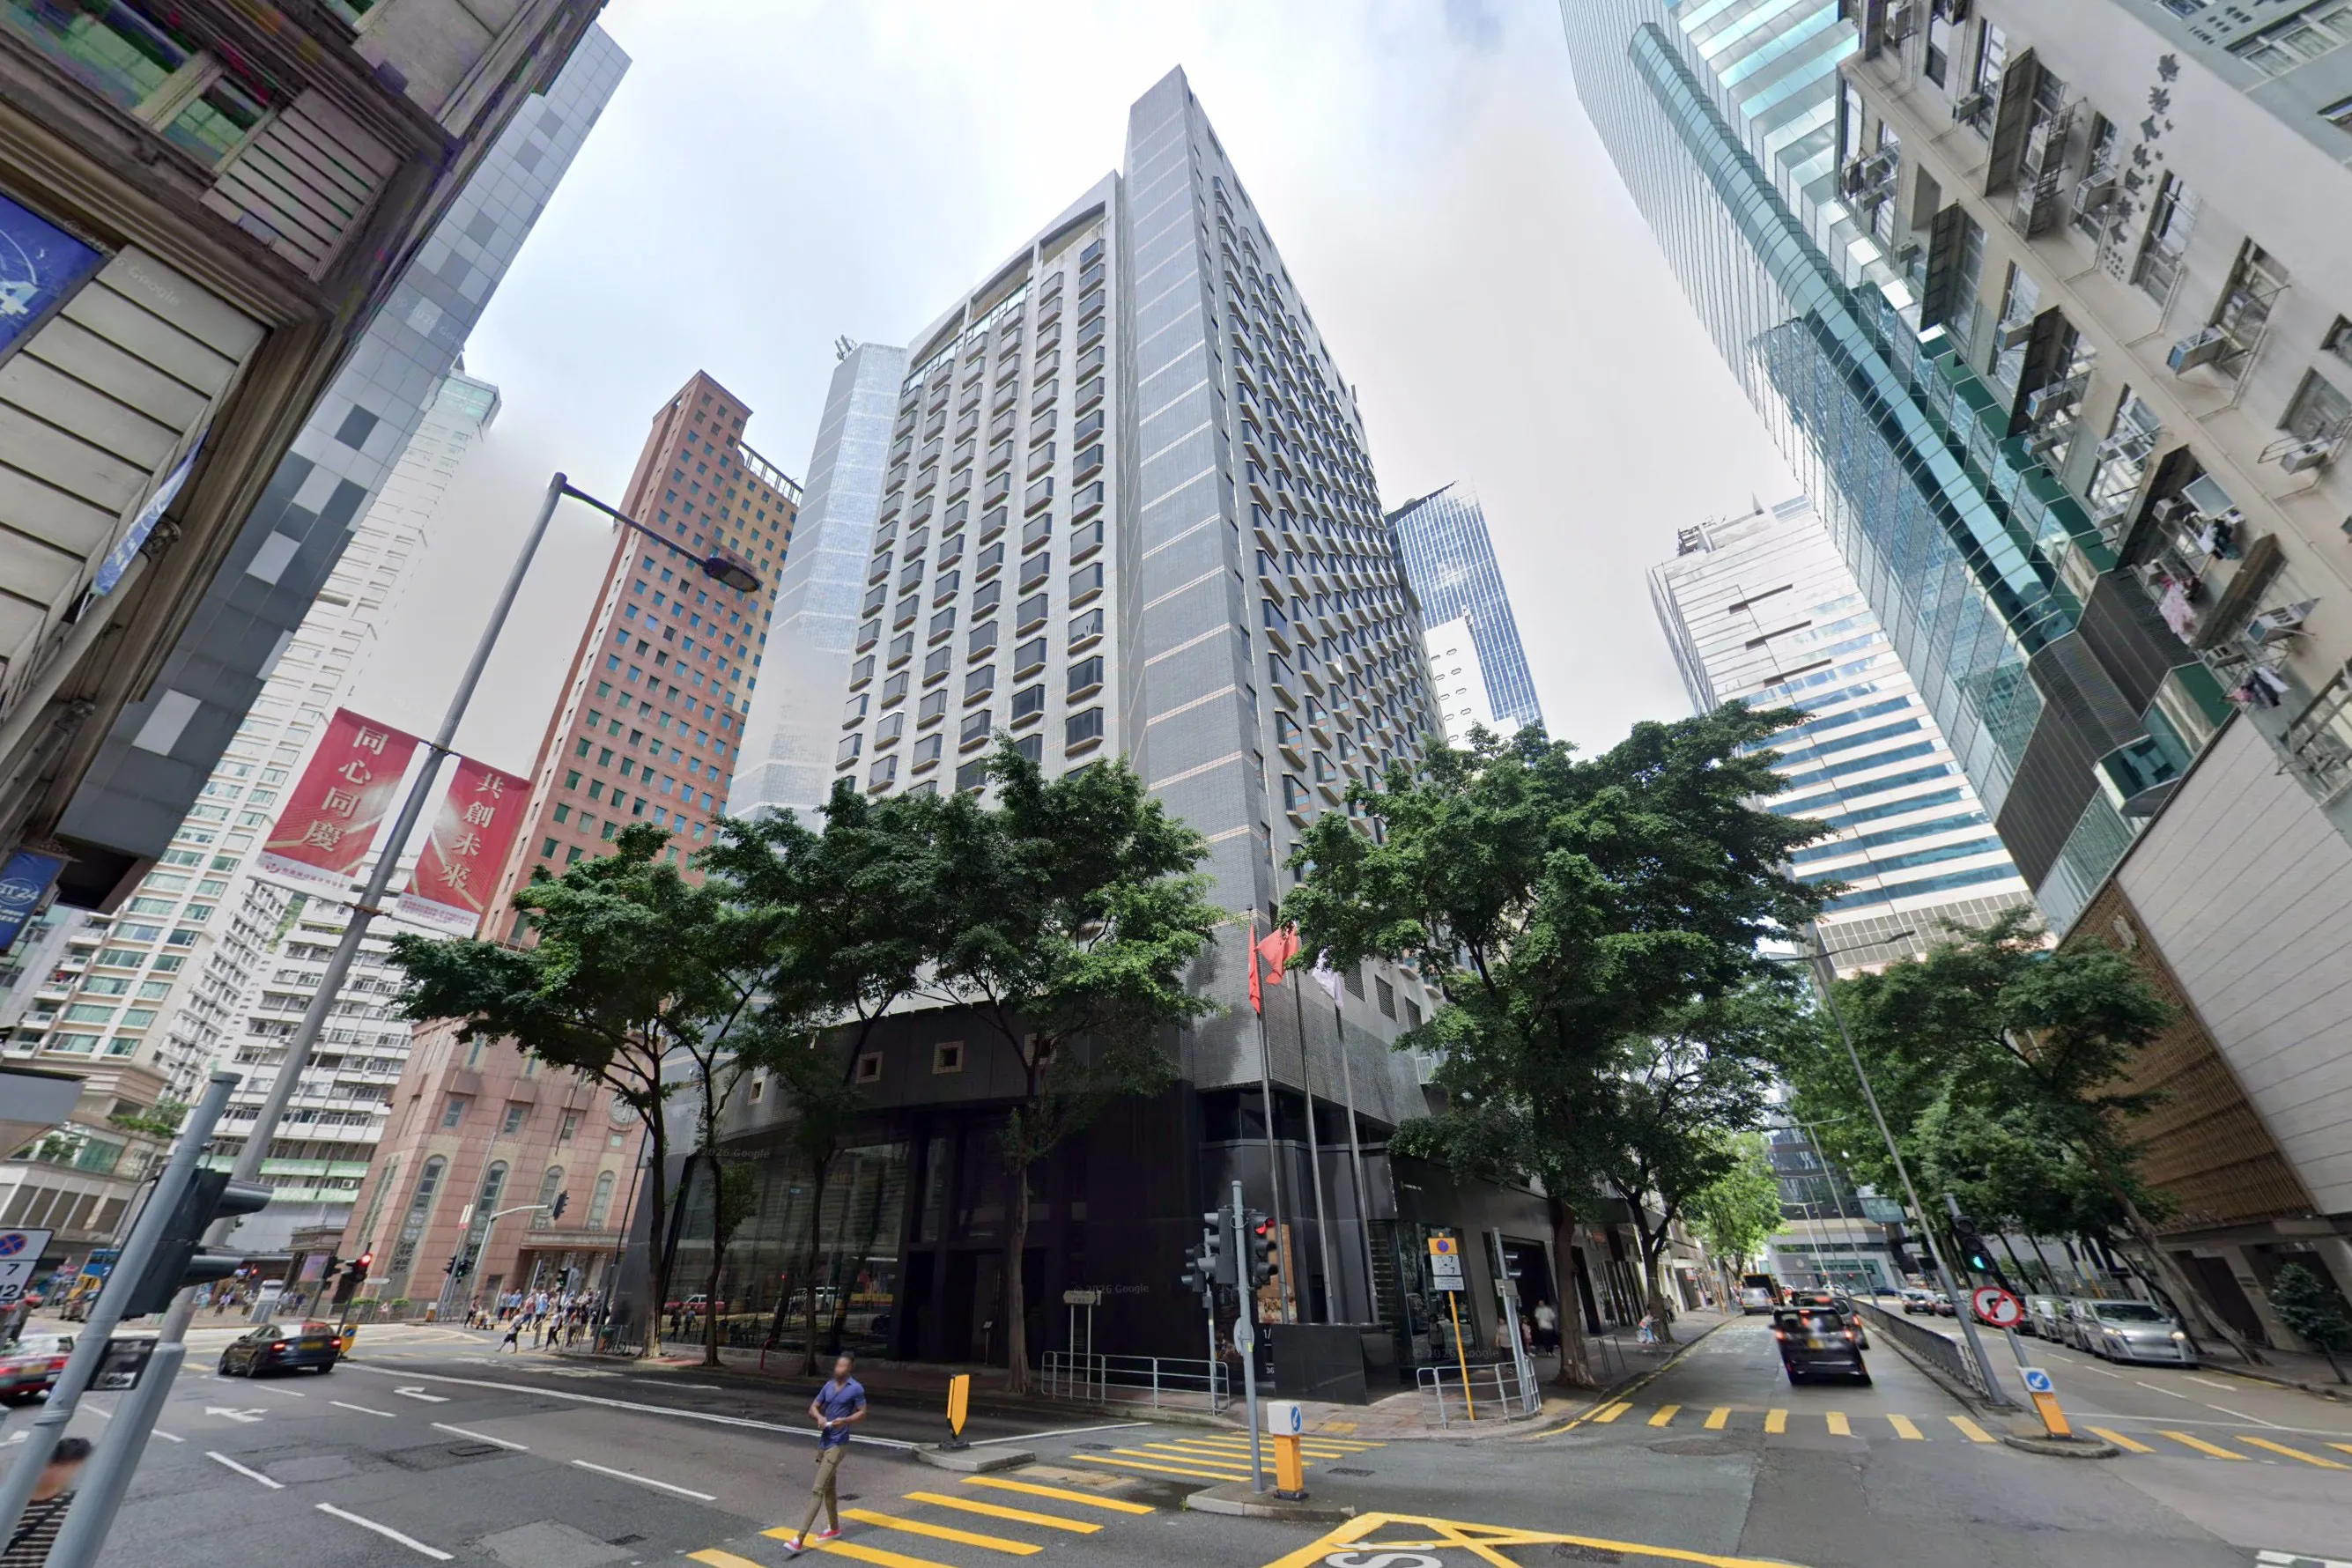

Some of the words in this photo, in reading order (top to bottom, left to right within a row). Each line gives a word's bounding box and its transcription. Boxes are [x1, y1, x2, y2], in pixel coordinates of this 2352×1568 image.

[304, 726, 389, 852] 同心同慶
[438, 773, 505, 889] 共創未來
[7, 1263, 20, 1276] 7
